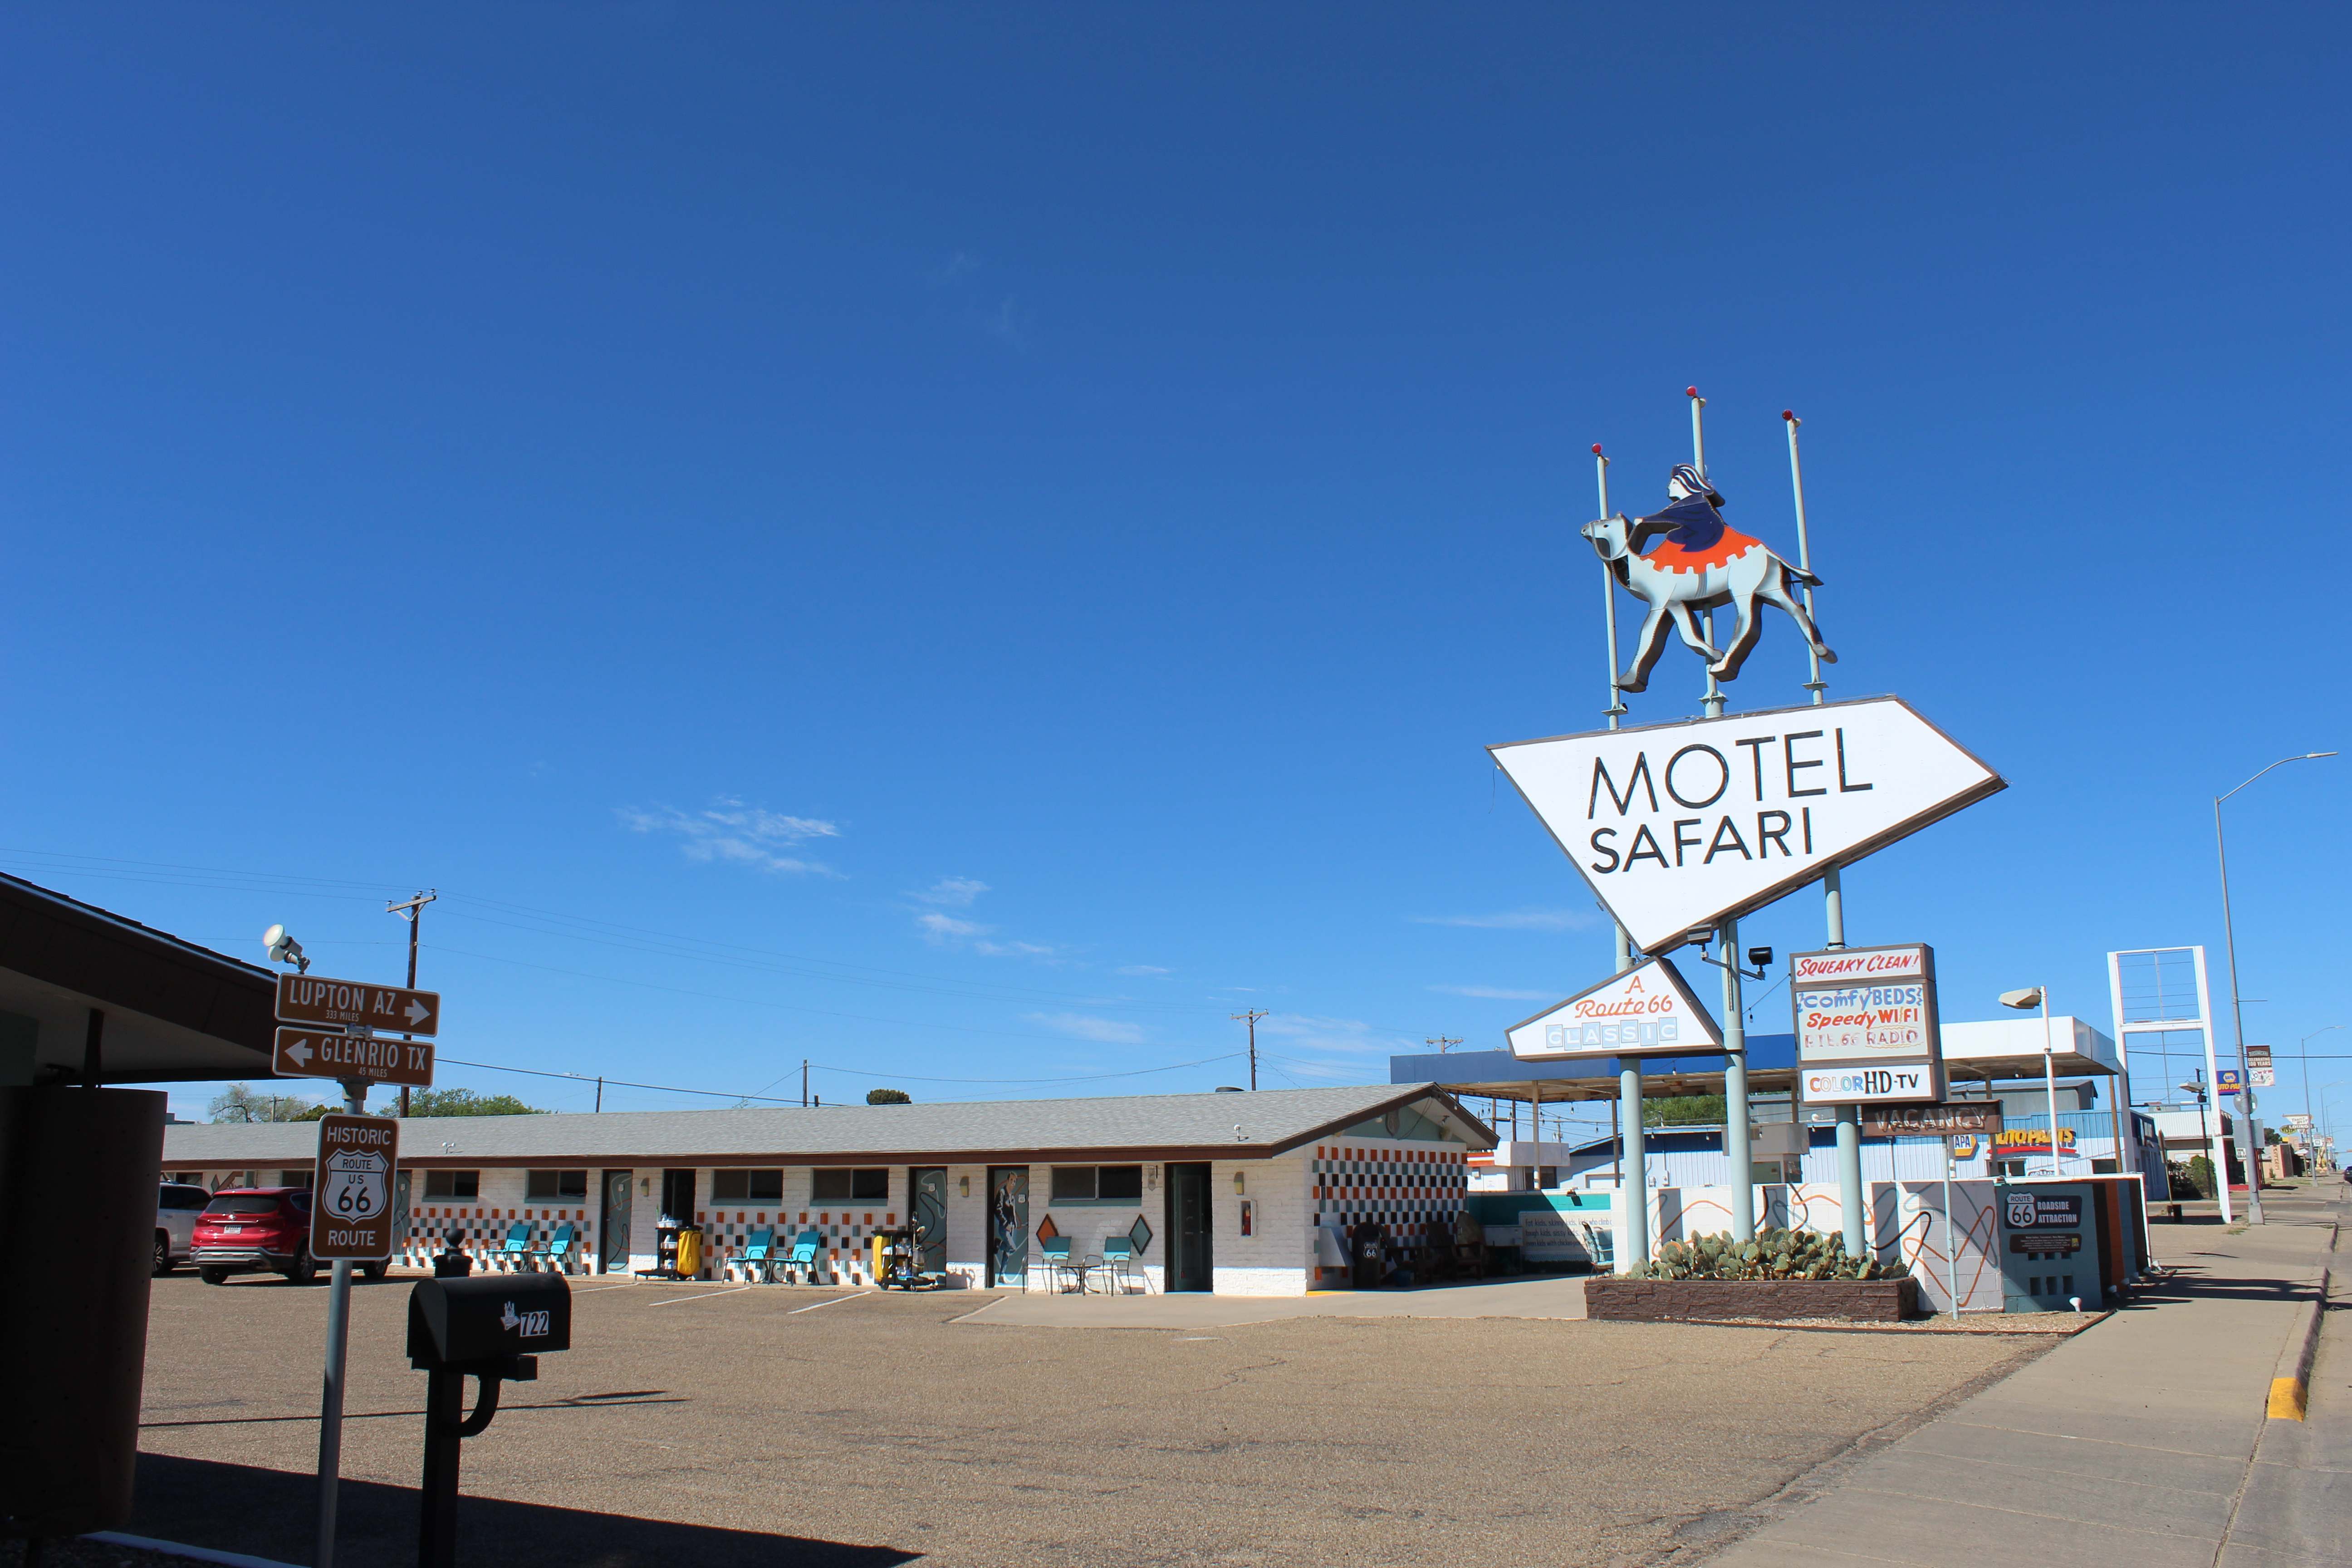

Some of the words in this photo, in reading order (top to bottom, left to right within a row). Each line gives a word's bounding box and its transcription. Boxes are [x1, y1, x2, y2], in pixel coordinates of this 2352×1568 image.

[1588, 728, 1872, 820] MOTEL
[1590, 807, 1812, 874] SAFARI
[1797, 956, 1864, 976] SQUEAKY
[1867, 954, 1920, 972] CLEAN!
[1624, 975, 1646, 994] A
[289, 980, 365, 1012] LUPTON
[373, 993, 395, 1015] AZ
[1872, 987, 1916, 1006] BEDS
[325, 1009, 338, 1019] 333
[339, 1011, 359, 1022] MILES
[1574, 998, 1645, 1019] Route
[1647, 995, 1673, 1014] 66
[1807, 1011, 1877, 1030] Speedy
[1548, 1024, 1676, 1045] CLASSIC
[1866, 1029, 1918, 1045] RADIO
[320, 1037, 398, 1068] GLENRIO
[407, 1046, 425, 1071] TX
[358, 1067, 366, 1076] 45
[368, 1068, 387, 1078] MILES
[1809, 1075, 1863, 1093] COLOR
[1875, 1107, 1987, 1132] VACANCY
[327, 1126, 391, 1146] HISTORIC
[1955, 1136, 1970, 1148] APA
[343, 1159, 372, 1170] ROUTE
[348, 1174, 364, 1185] US
[338, 1186, 371, 1213] 66
[2037, 1201, 2069, 1210] ROADSIDE
[2012, 1205, 2032, 1223] 66
[2038, 1214, 2077, 1223] ATTRACTION
[328, 1230, 376, 1246] ROUTE
[1366, 1249, 1376, 1257] 66
[521, 1312, 548, 1336] 722
